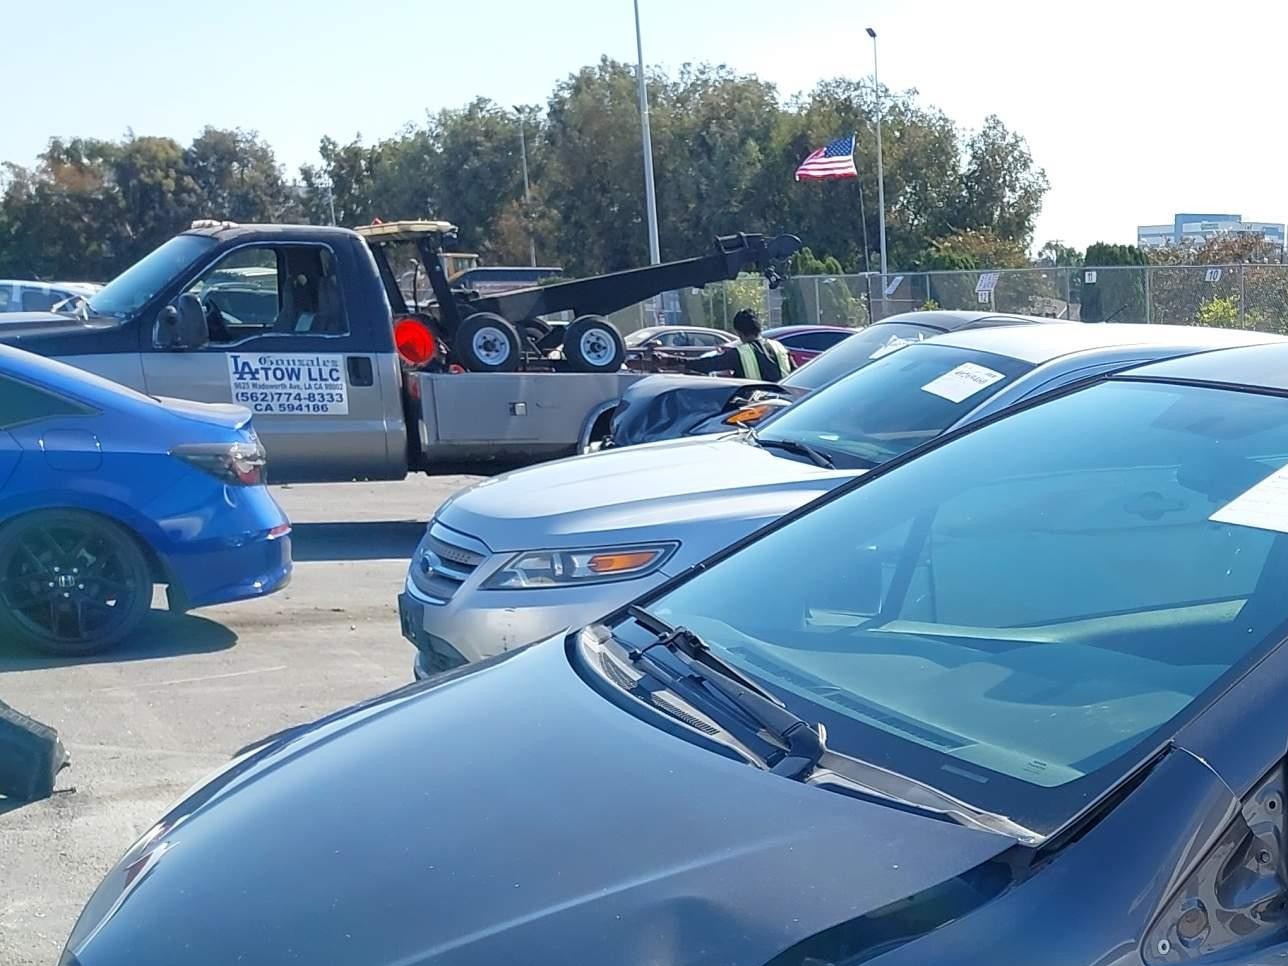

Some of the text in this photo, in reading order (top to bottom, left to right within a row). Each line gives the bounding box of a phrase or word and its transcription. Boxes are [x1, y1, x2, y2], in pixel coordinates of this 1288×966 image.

[230, 354, 260, 381] LA
[260, 367, 341, 382] TOW LLC
[304, 382, 313, 391] LA
[314, 382, 323, 391] CA
[235, 391, 344, 403] (562)774-8333
[254, 403, 329, 413] CA 594186
